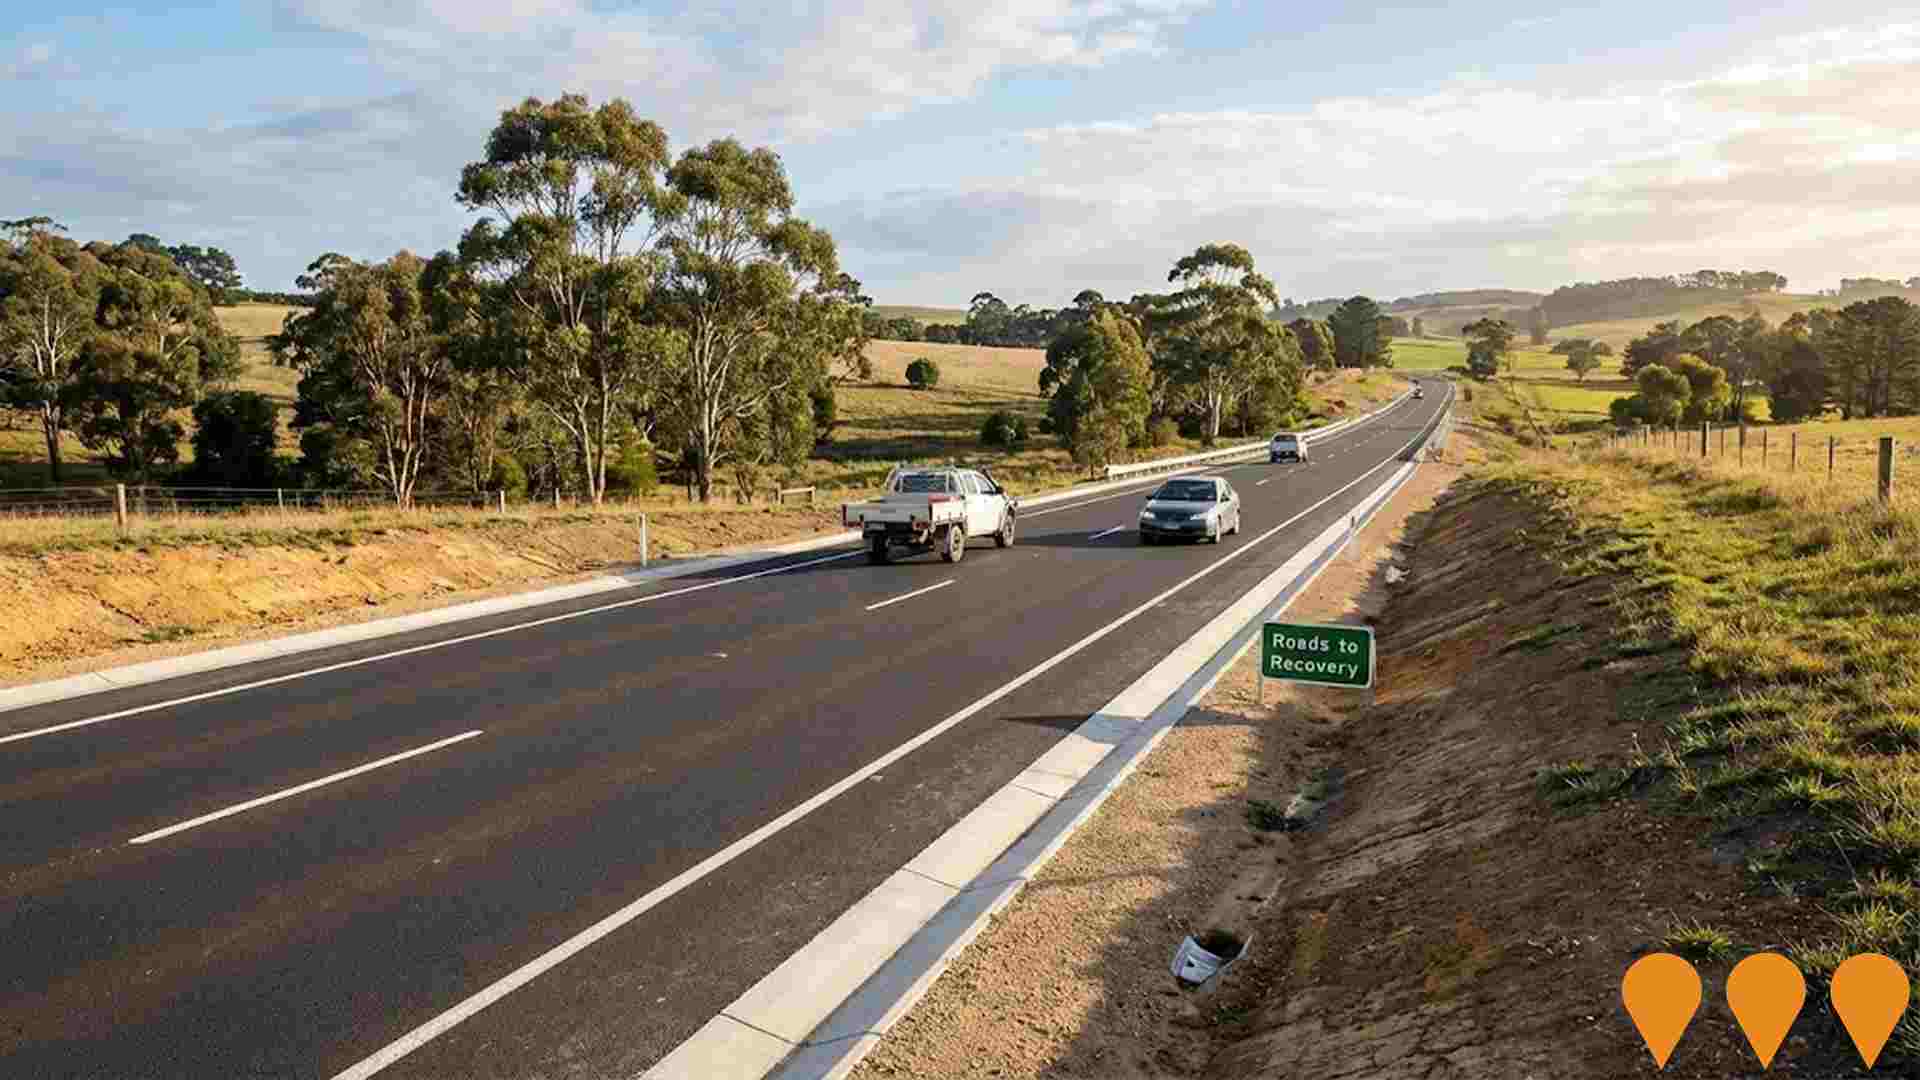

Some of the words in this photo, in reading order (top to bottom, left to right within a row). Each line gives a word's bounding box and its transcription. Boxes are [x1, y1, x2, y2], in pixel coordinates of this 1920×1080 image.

[1272, 633, 1329, 652] Roads
[1339, 638, 1359, 654] to
[1270, 655, 1359, 679] Recovery
